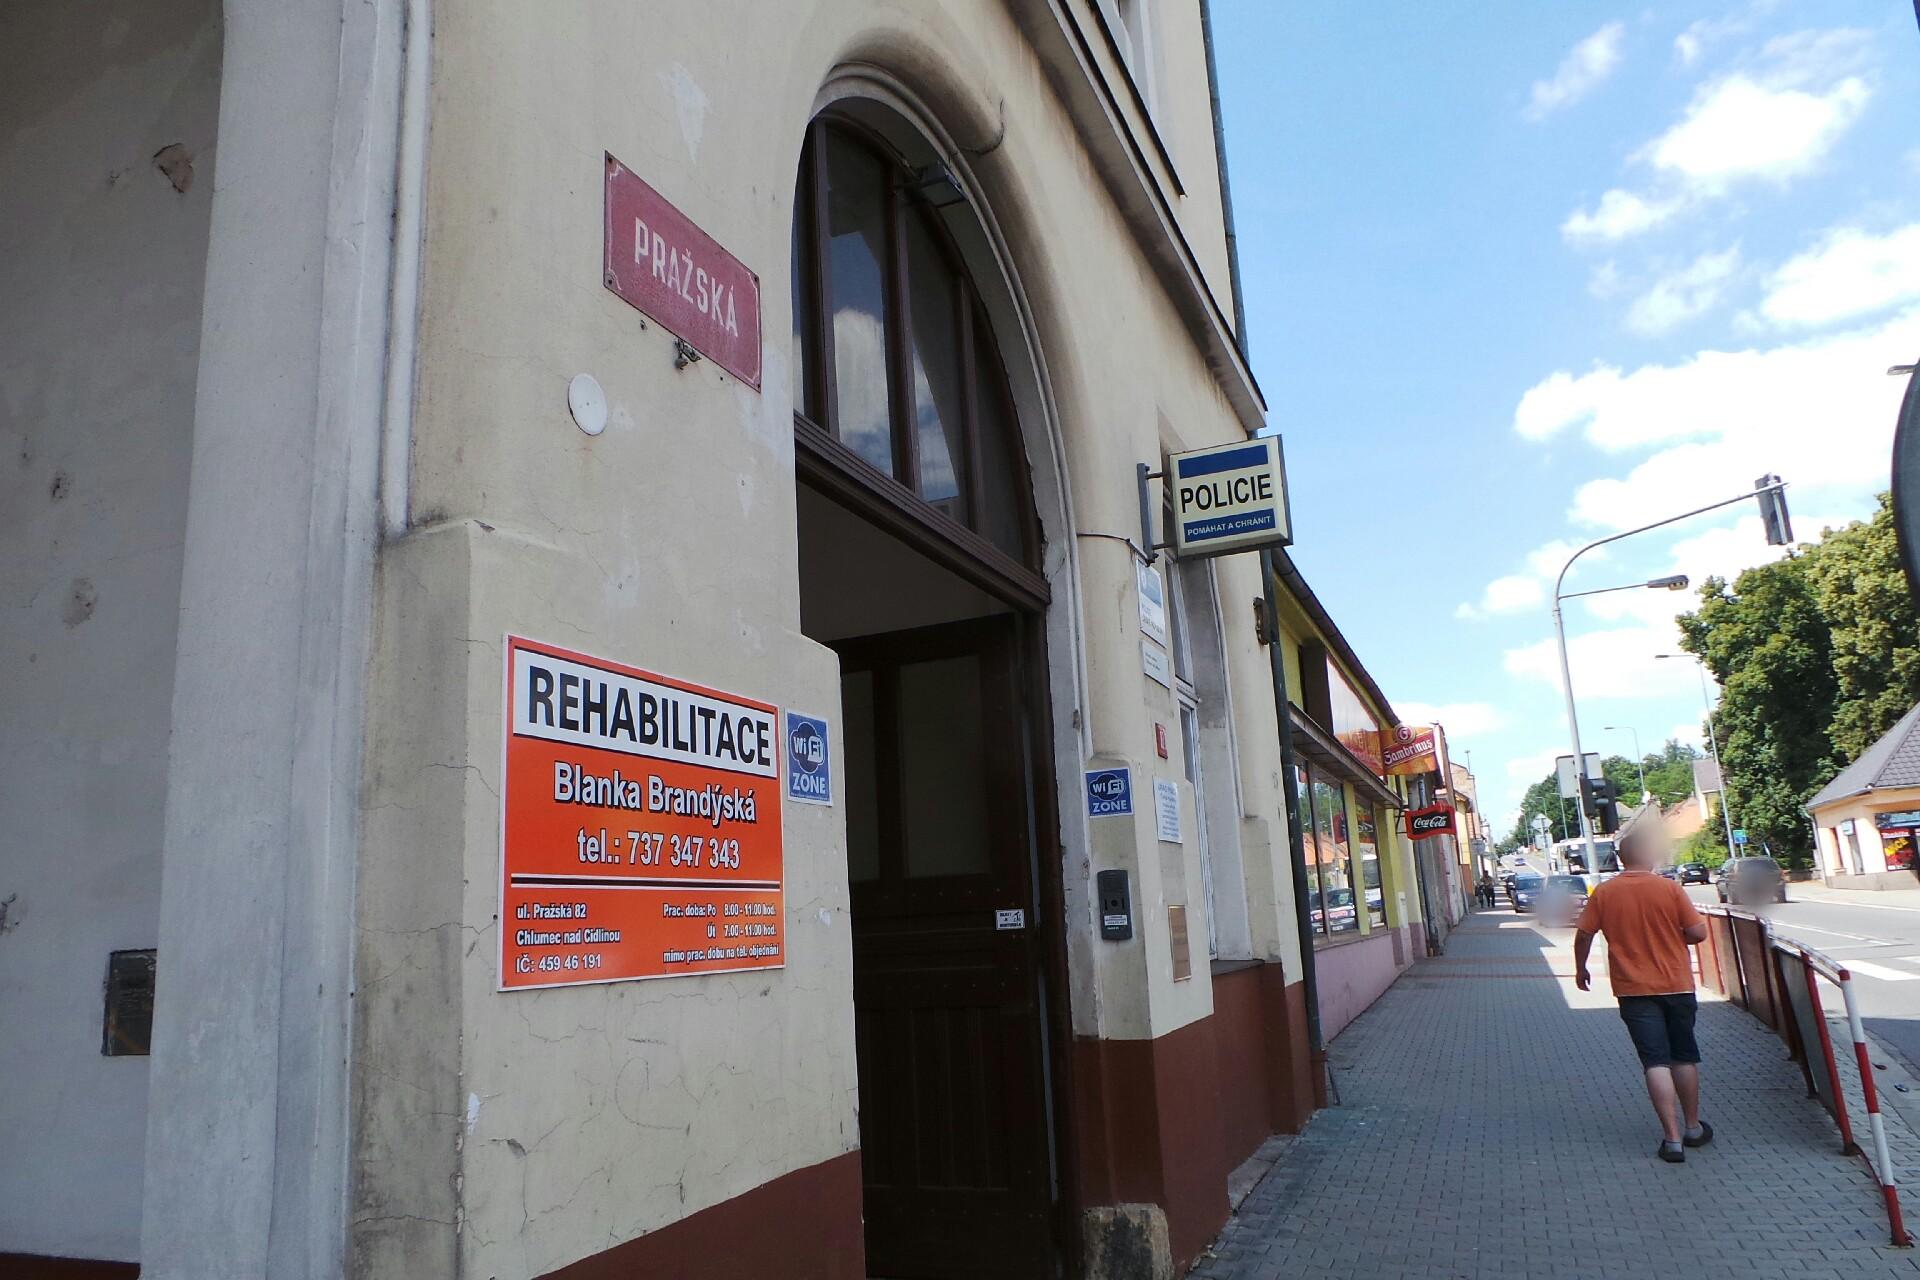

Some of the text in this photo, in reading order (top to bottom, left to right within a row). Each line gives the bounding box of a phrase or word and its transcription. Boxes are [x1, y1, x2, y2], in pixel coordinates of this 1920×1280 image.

[634, 216, 738, 338] PRAŽSKÁ
[1180, 473, 1273, 514] POLICIE
[1187, 515, 1271, 536] POMÁHAT A CHRÁNIT
[528, 665, 771, 767] REHABILITACE
[553, 761, 757, 827] Blanka Brandýská
[792, 773, 826, 794] ZONE
[1092, 800, 1128, 812] ZONE
[577, 827, 740, 870] tel.: 737 347 343
[517, 903, 587, 919] ul. Pražská 82
[663, 904, 684, 917] Prac.
[685, 904, 706, 916] doba:
[707, 903, 717, 916] Po
[745, 903, 762, 915] 11.00
[517, 928, 620, 945] Chlumec nad Cidlinou
[724, 924, 739, 937] 7.00
[745, 924, 762, 936] 11.00
[516, 953, 601, 973] IČ: 459 46 191
[663, 951, 685, 962] mimo
[687, 951, 706, 964] prac.
[707, 947, 725, 959] dobu
[726, 948, 735, 958] na
[749, 943, 779, 959] objednání
